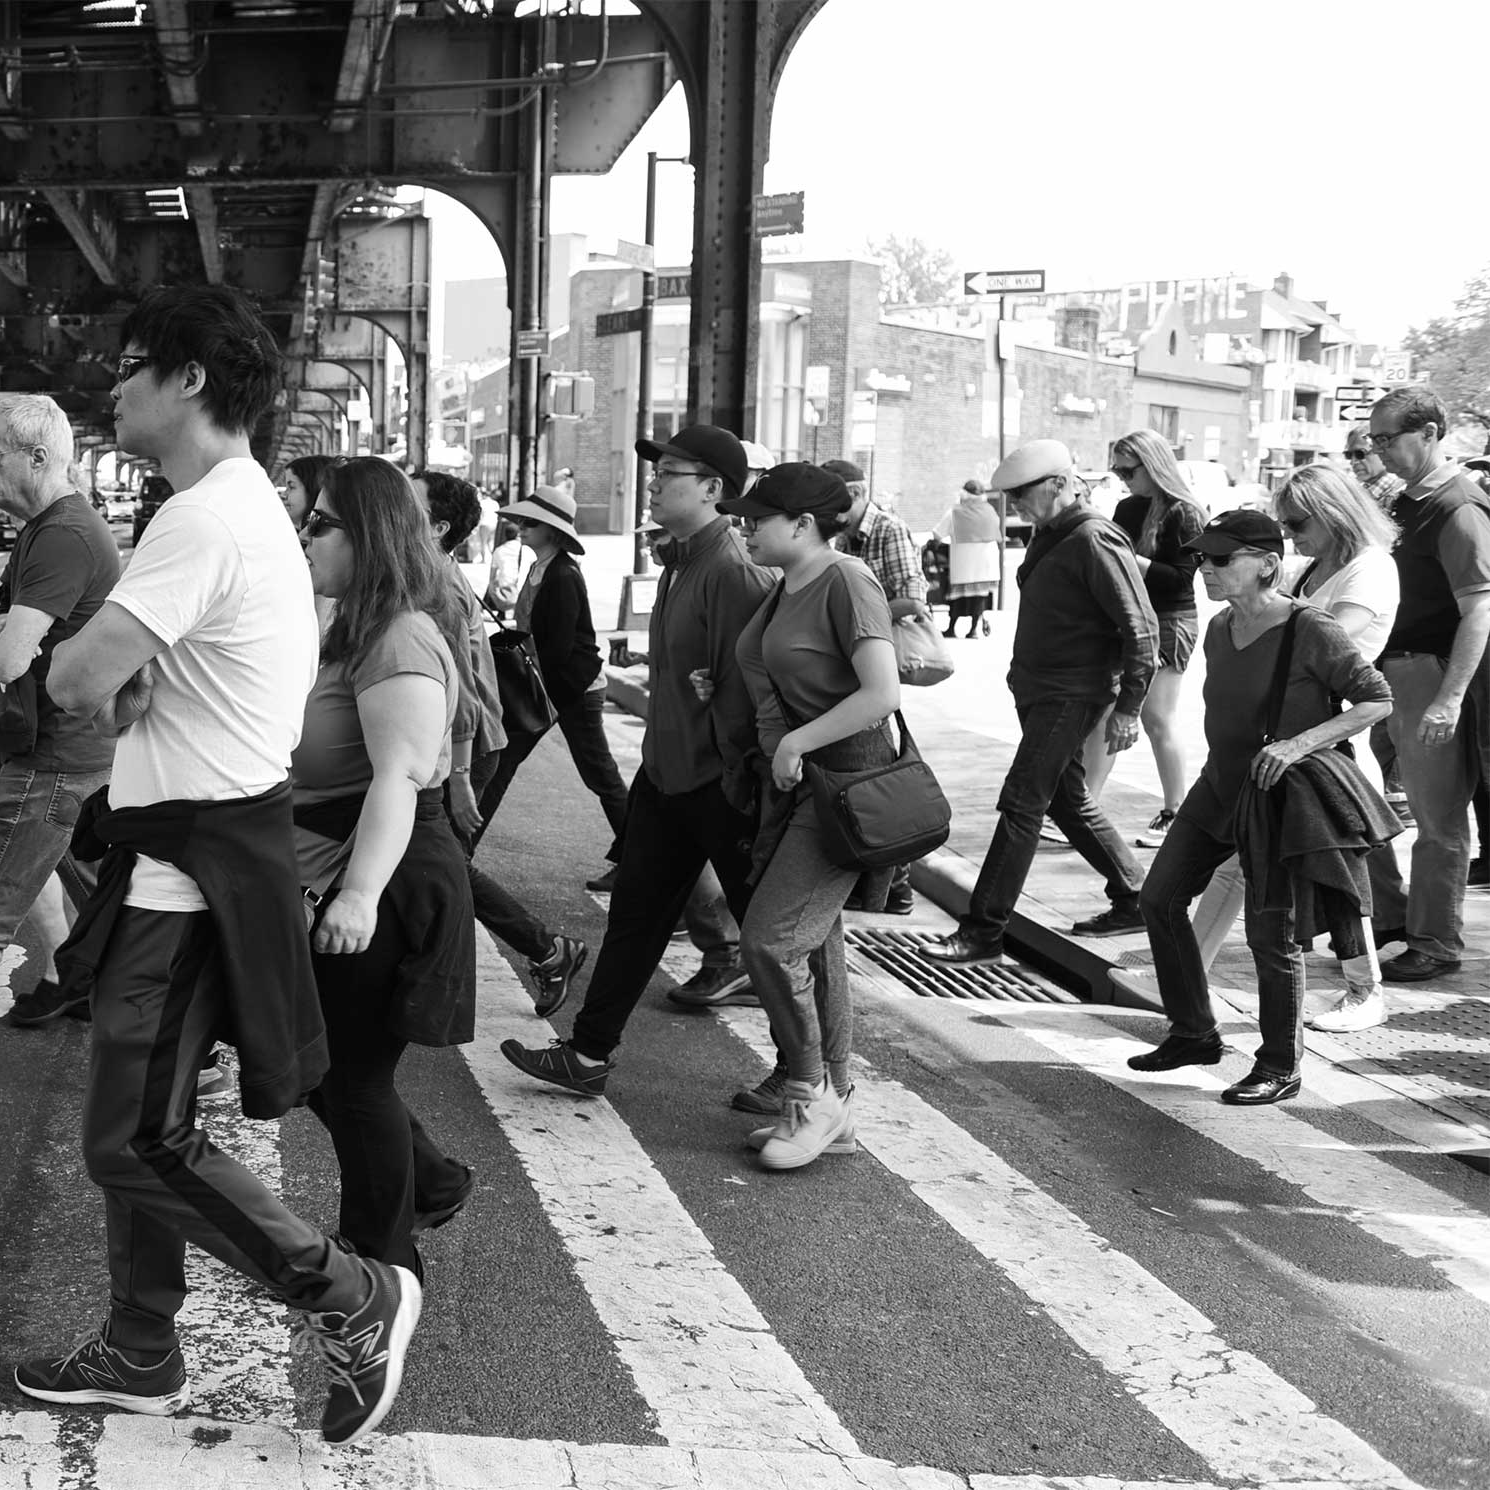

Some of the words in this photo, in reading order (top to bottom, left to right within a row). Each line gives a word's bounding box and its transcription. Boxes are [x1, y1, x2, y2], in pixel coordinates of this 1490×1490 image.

[661, 278, 688, 297] BAX
[988, 277, 1011, 290] ONE
[1014, 275, 1038, 289] WAY
[1386, 368, 1406, 381] 20
